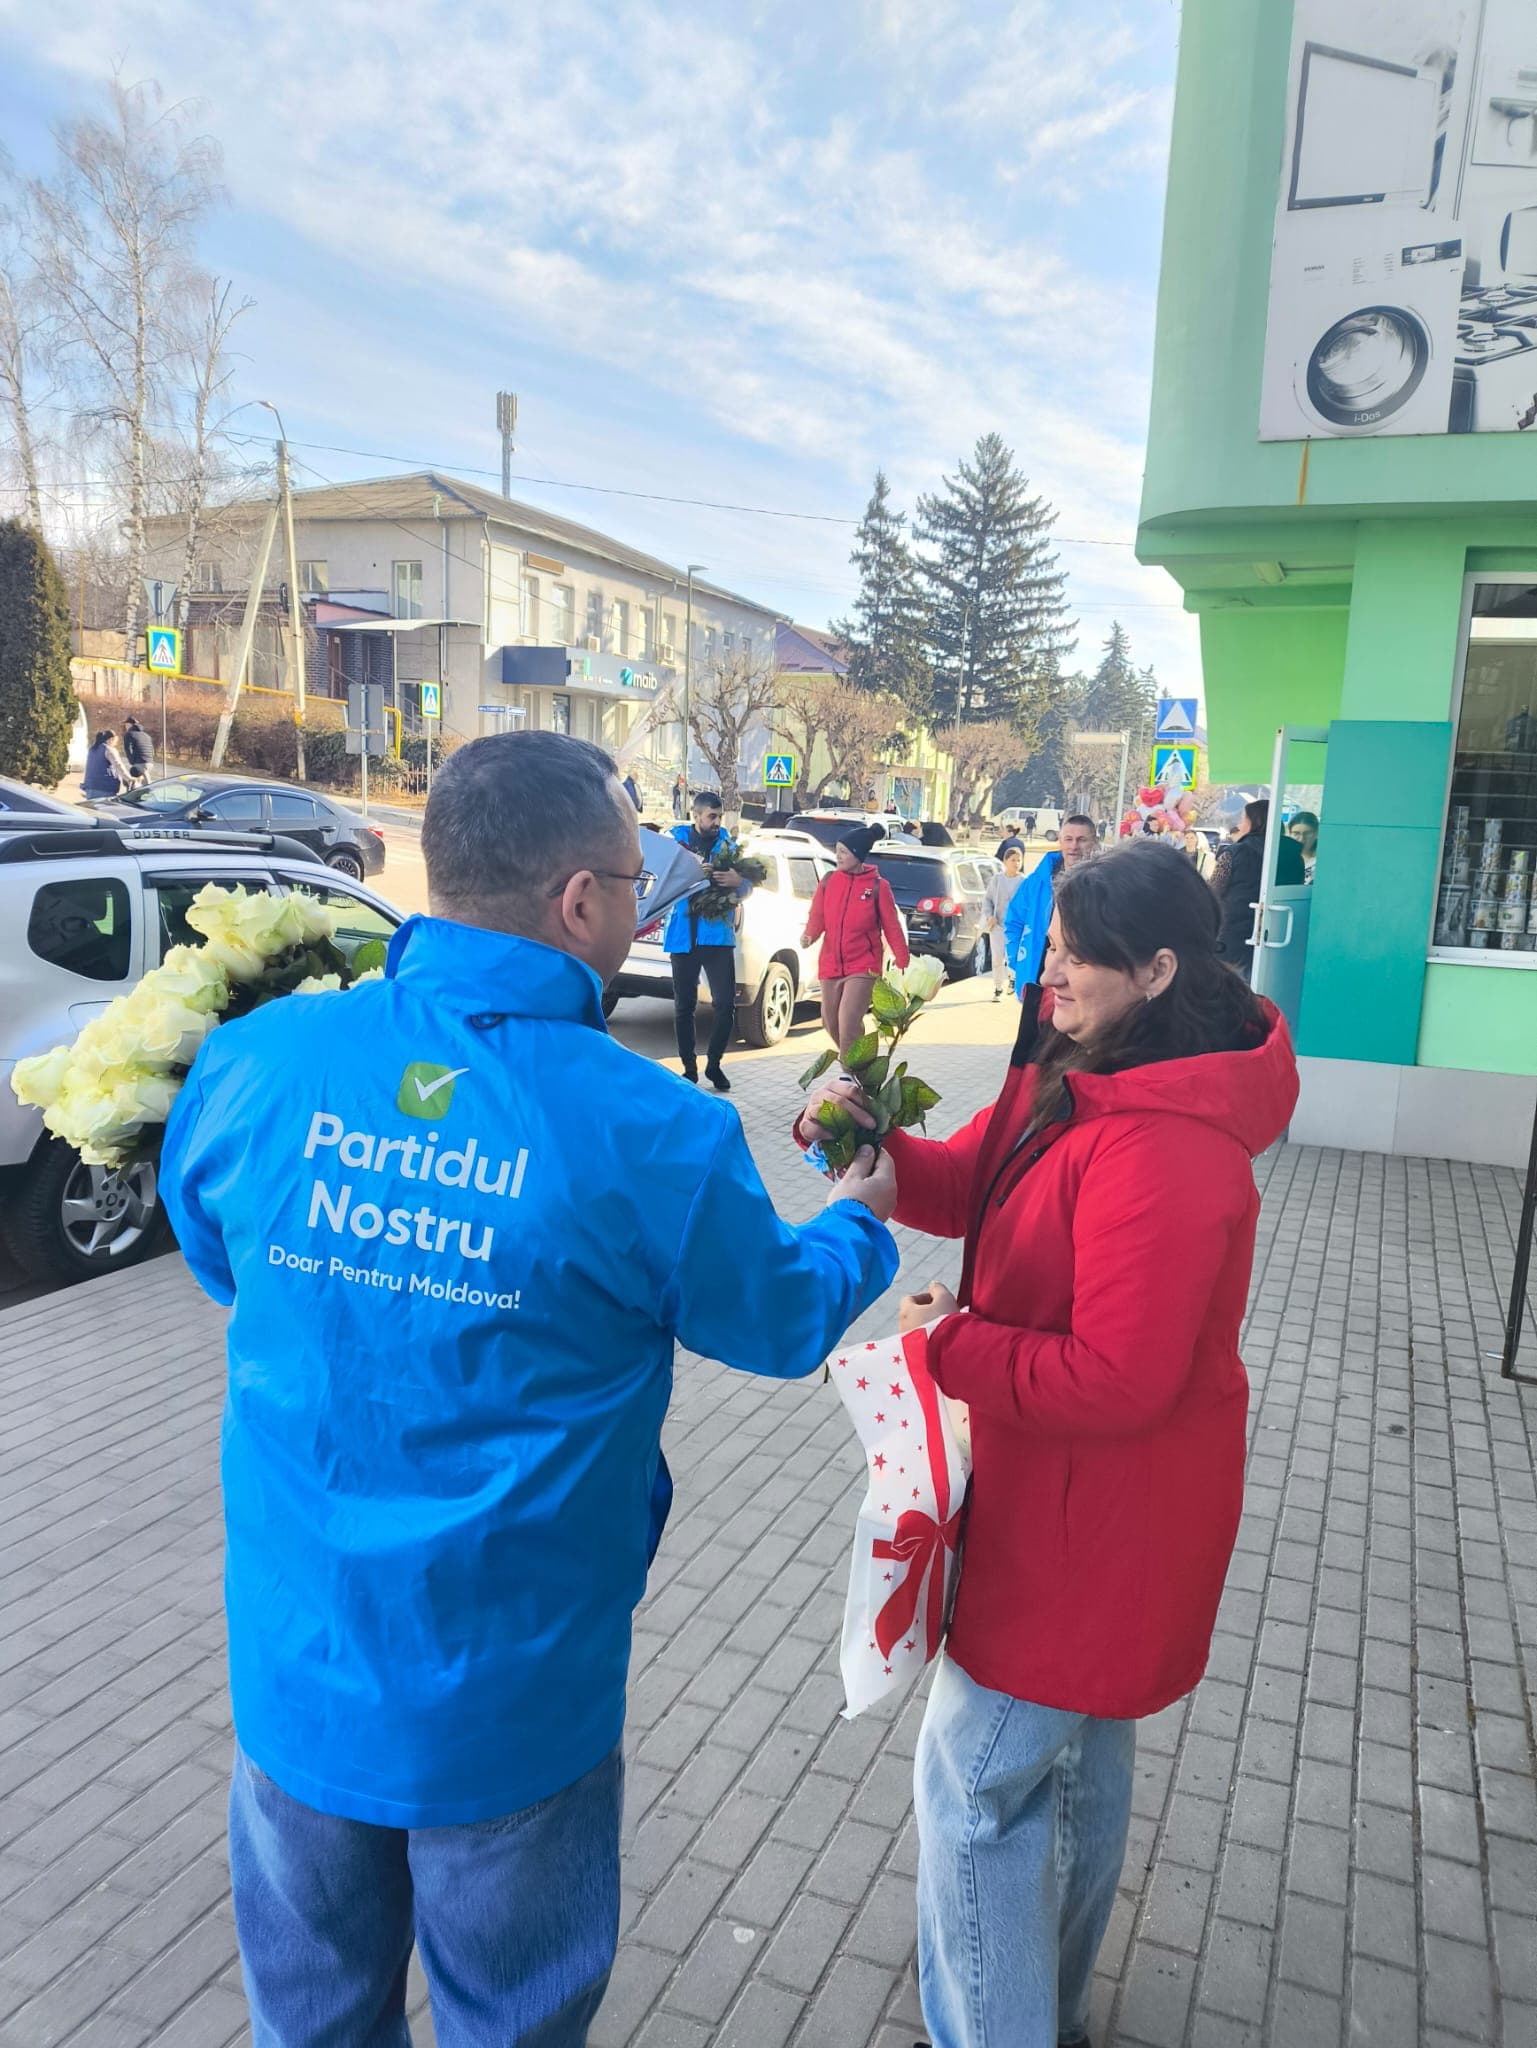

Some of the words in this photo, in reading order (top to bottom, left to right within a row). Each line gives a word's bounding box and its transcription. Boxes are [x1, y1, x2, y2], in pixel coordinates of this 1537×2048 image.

[1353, 411, 1381, 423] i-Dos
[633, 671, 658, 690] maib
[133, 830, 190, 839] DUSTER
[303, 1111, 529, 1199] Partidul
[307, 1179, 494, 1262] Nostru
[268, 1245, 324, 1275] Doar
[329, 1257, 403, 1291] Pentru
[408, 1273, 521, 1310] Moldova!
